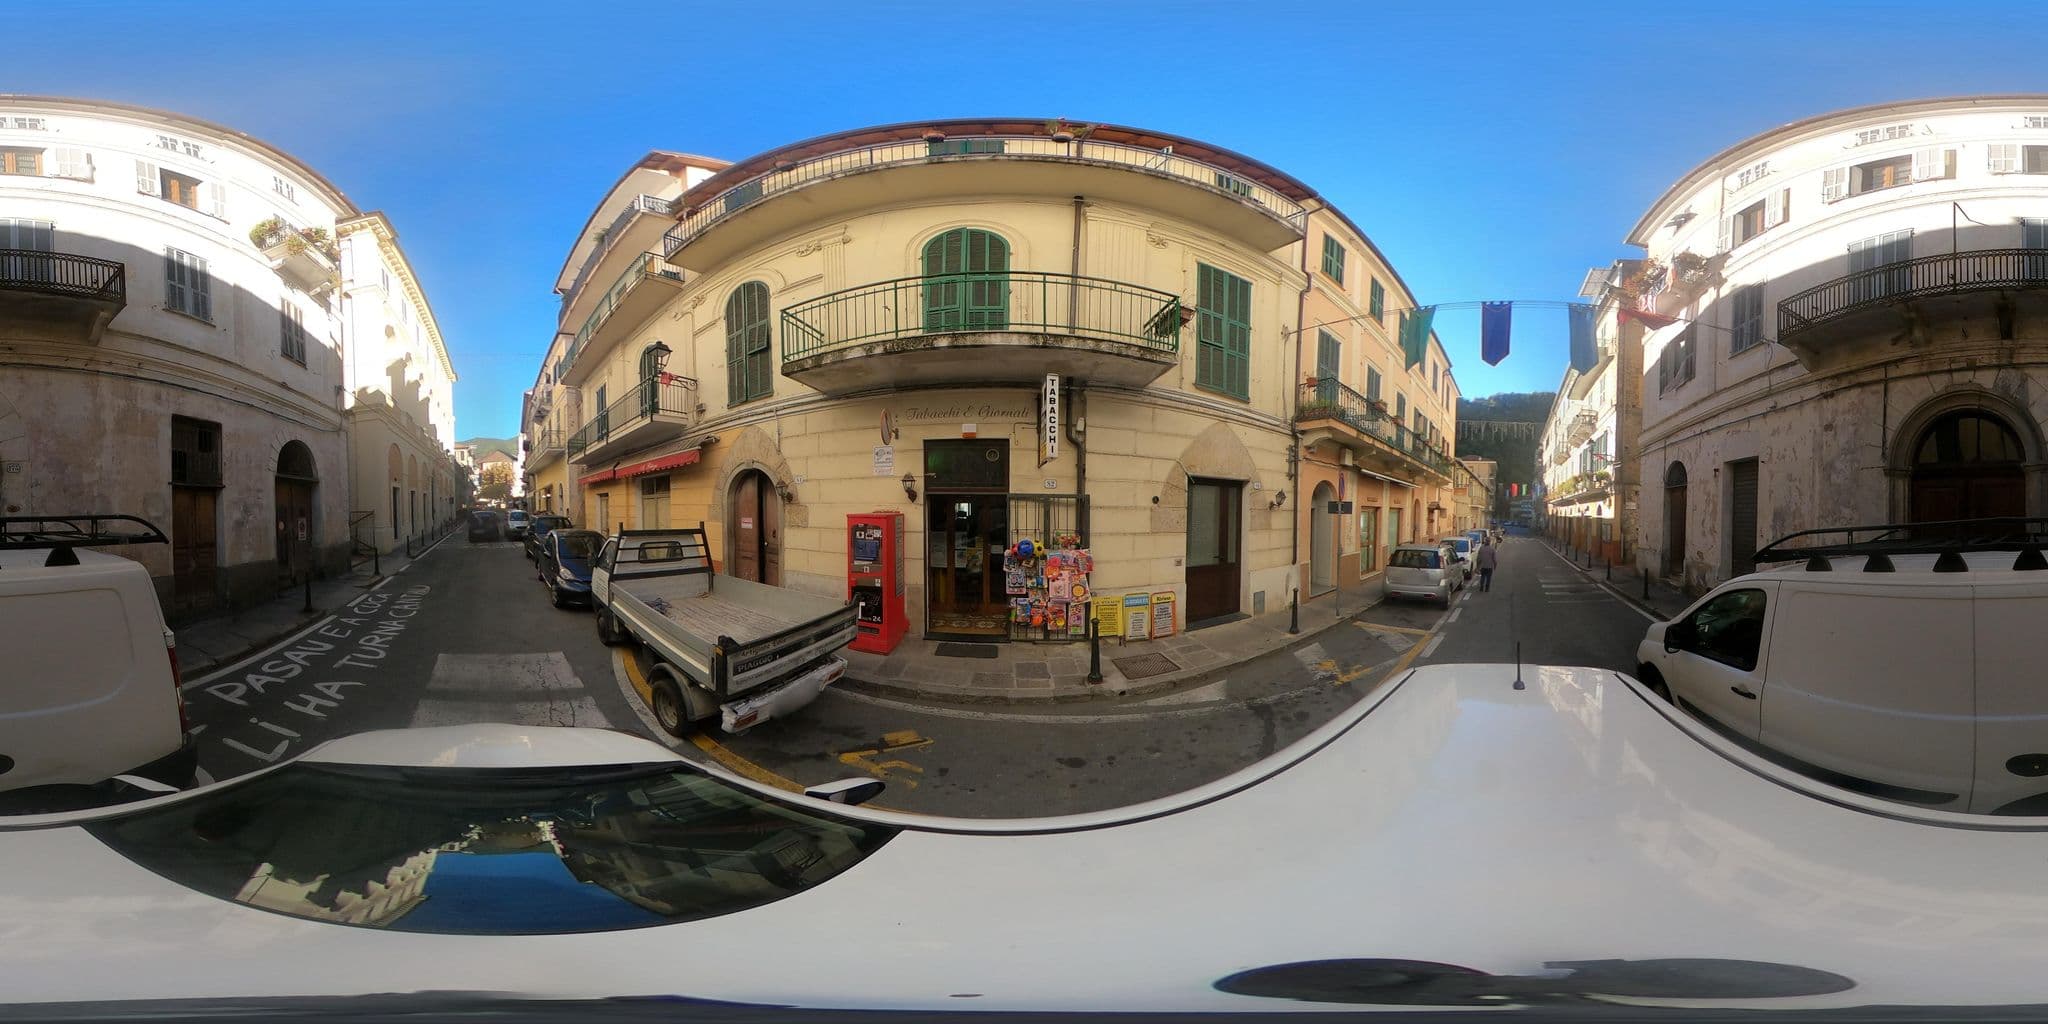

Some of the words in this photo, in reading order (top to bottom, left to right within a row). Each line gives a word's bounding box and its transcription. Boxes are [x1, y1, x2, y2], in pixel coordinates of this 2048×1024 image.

[978, 405, 1030, 421] Giornali
[1048, 378, 1057, 453] TABACCHI
[283, 680, 368, 721] HA
[332, 618, 409, 669] TURNA
[736, 654, 774, 673] PIAGGIO
